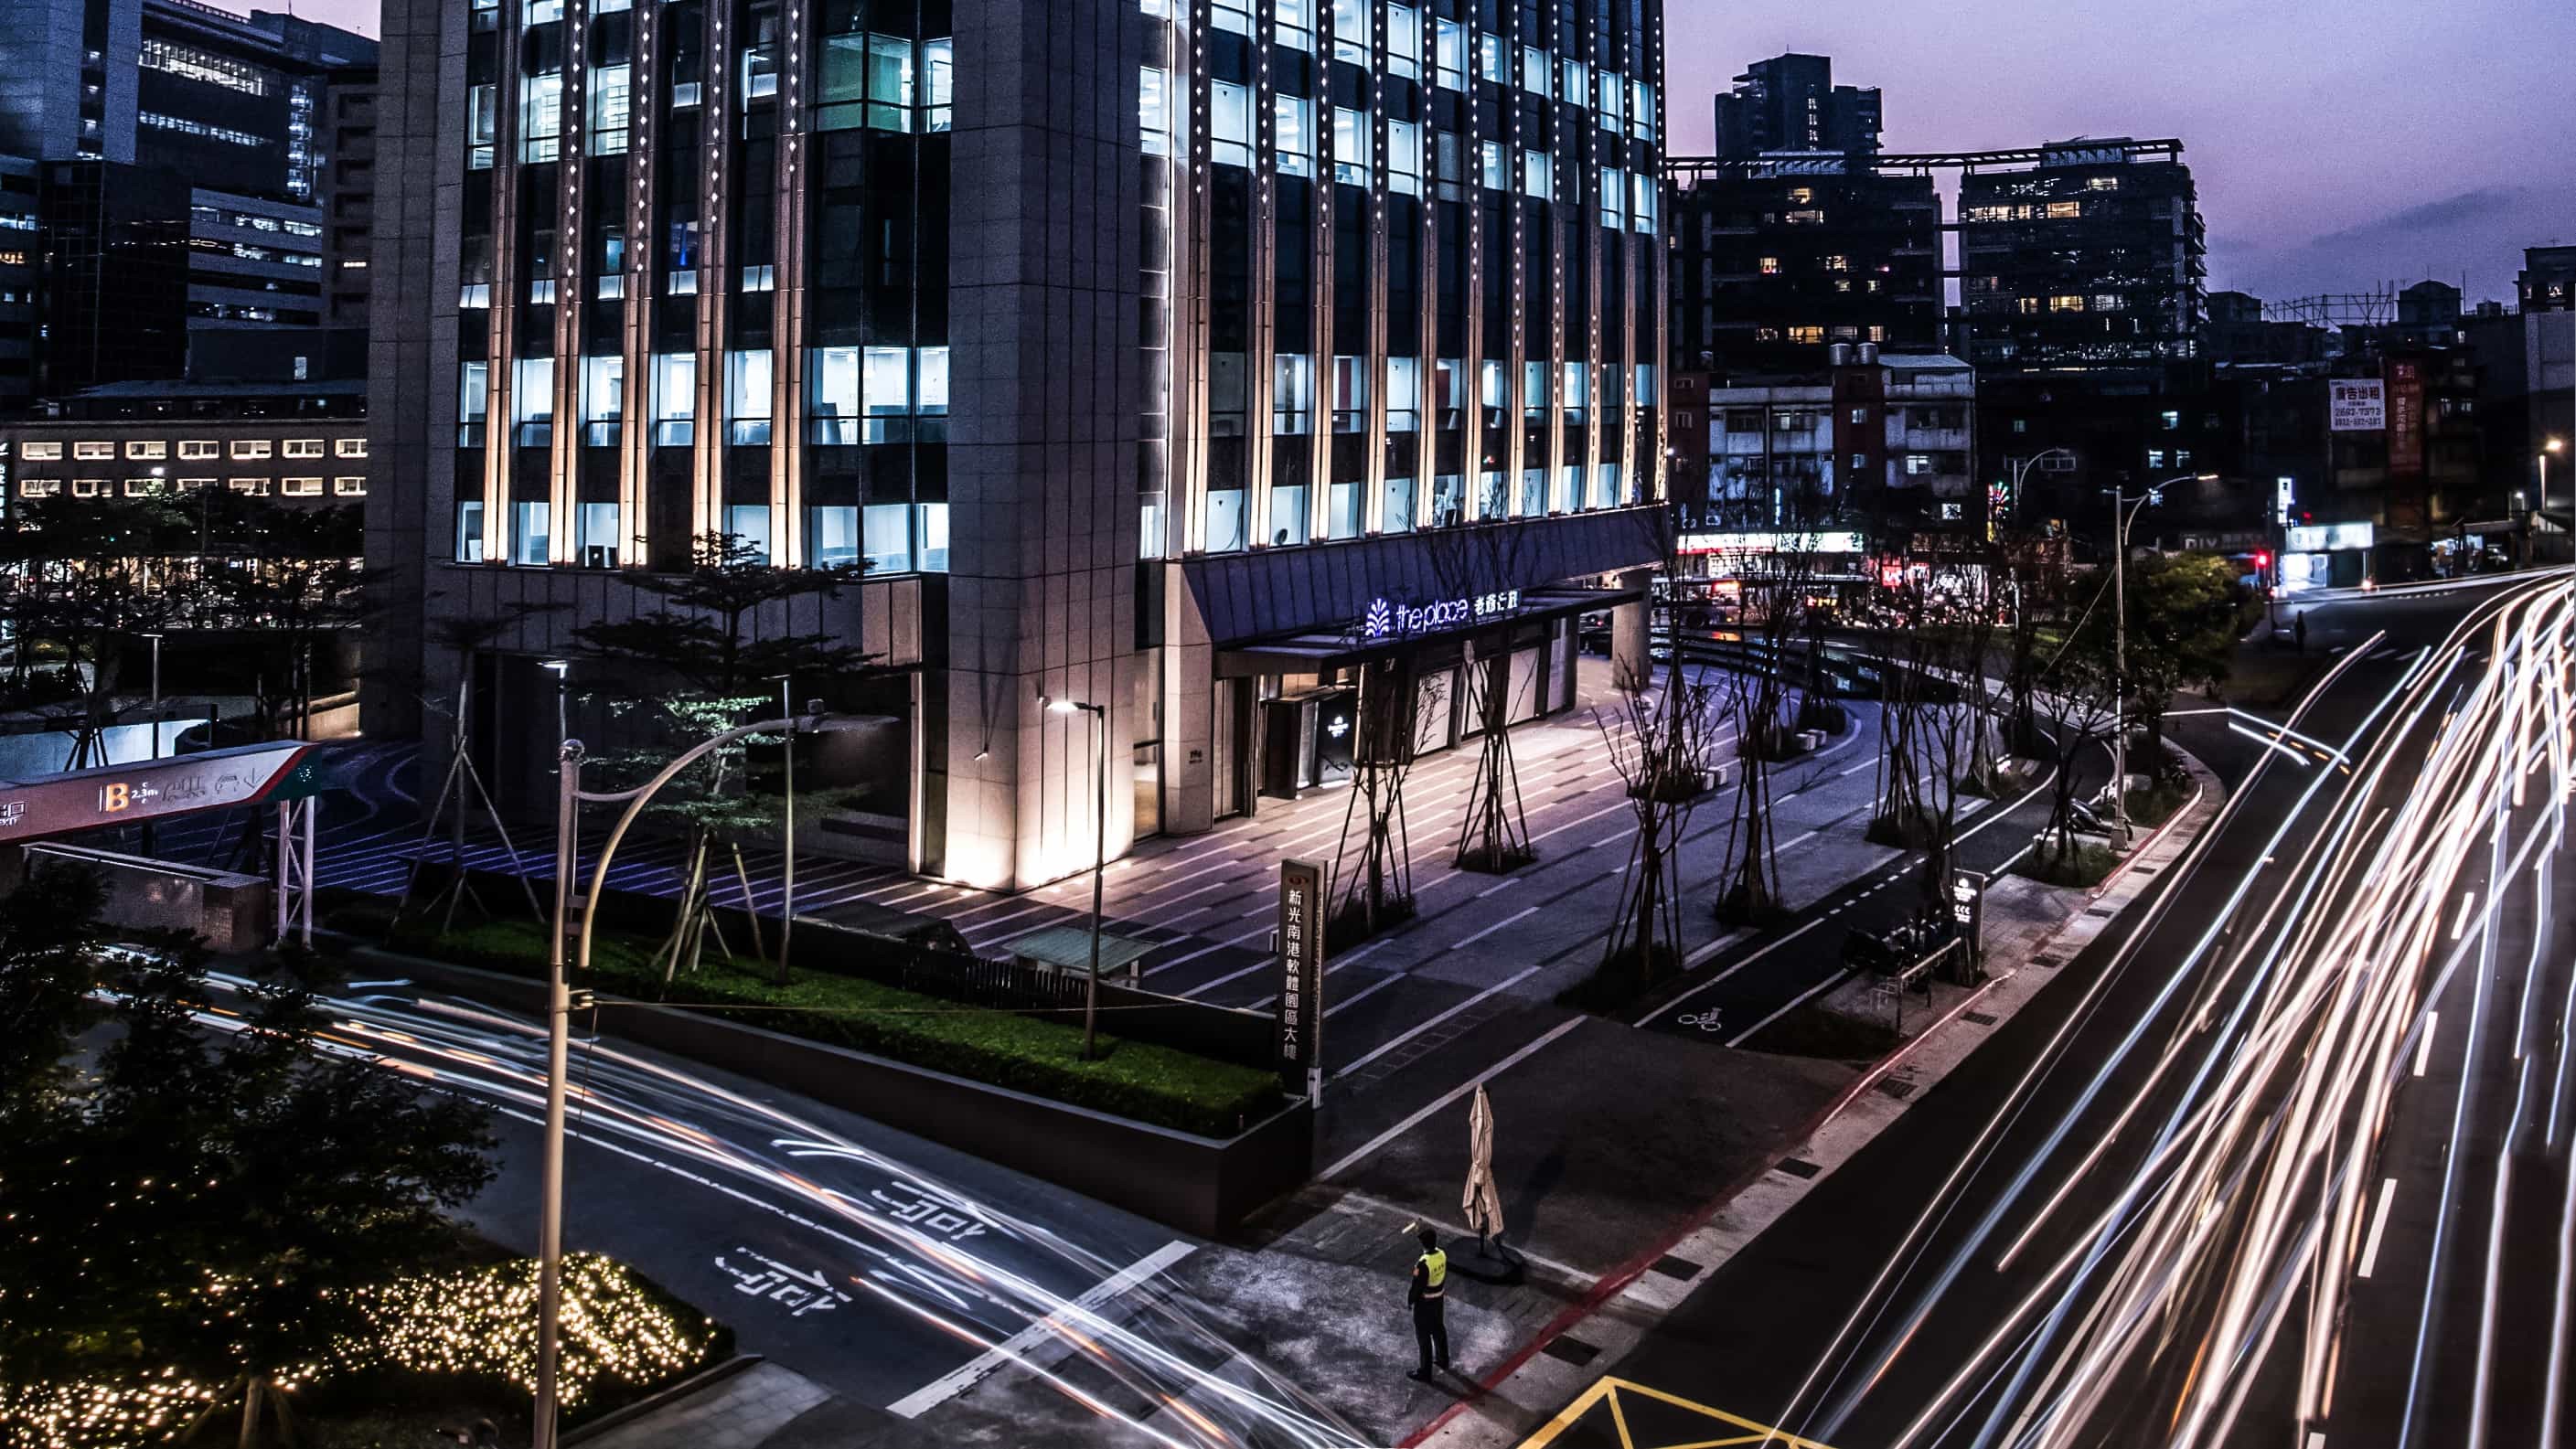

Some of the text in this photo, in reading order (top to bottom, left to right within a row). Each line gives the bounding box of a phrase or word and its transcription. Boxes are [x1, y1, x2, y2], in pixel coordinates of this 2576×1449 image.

[2336, 387, 2379, 400] 廣告出租
[105, 783, 129, 812] B
